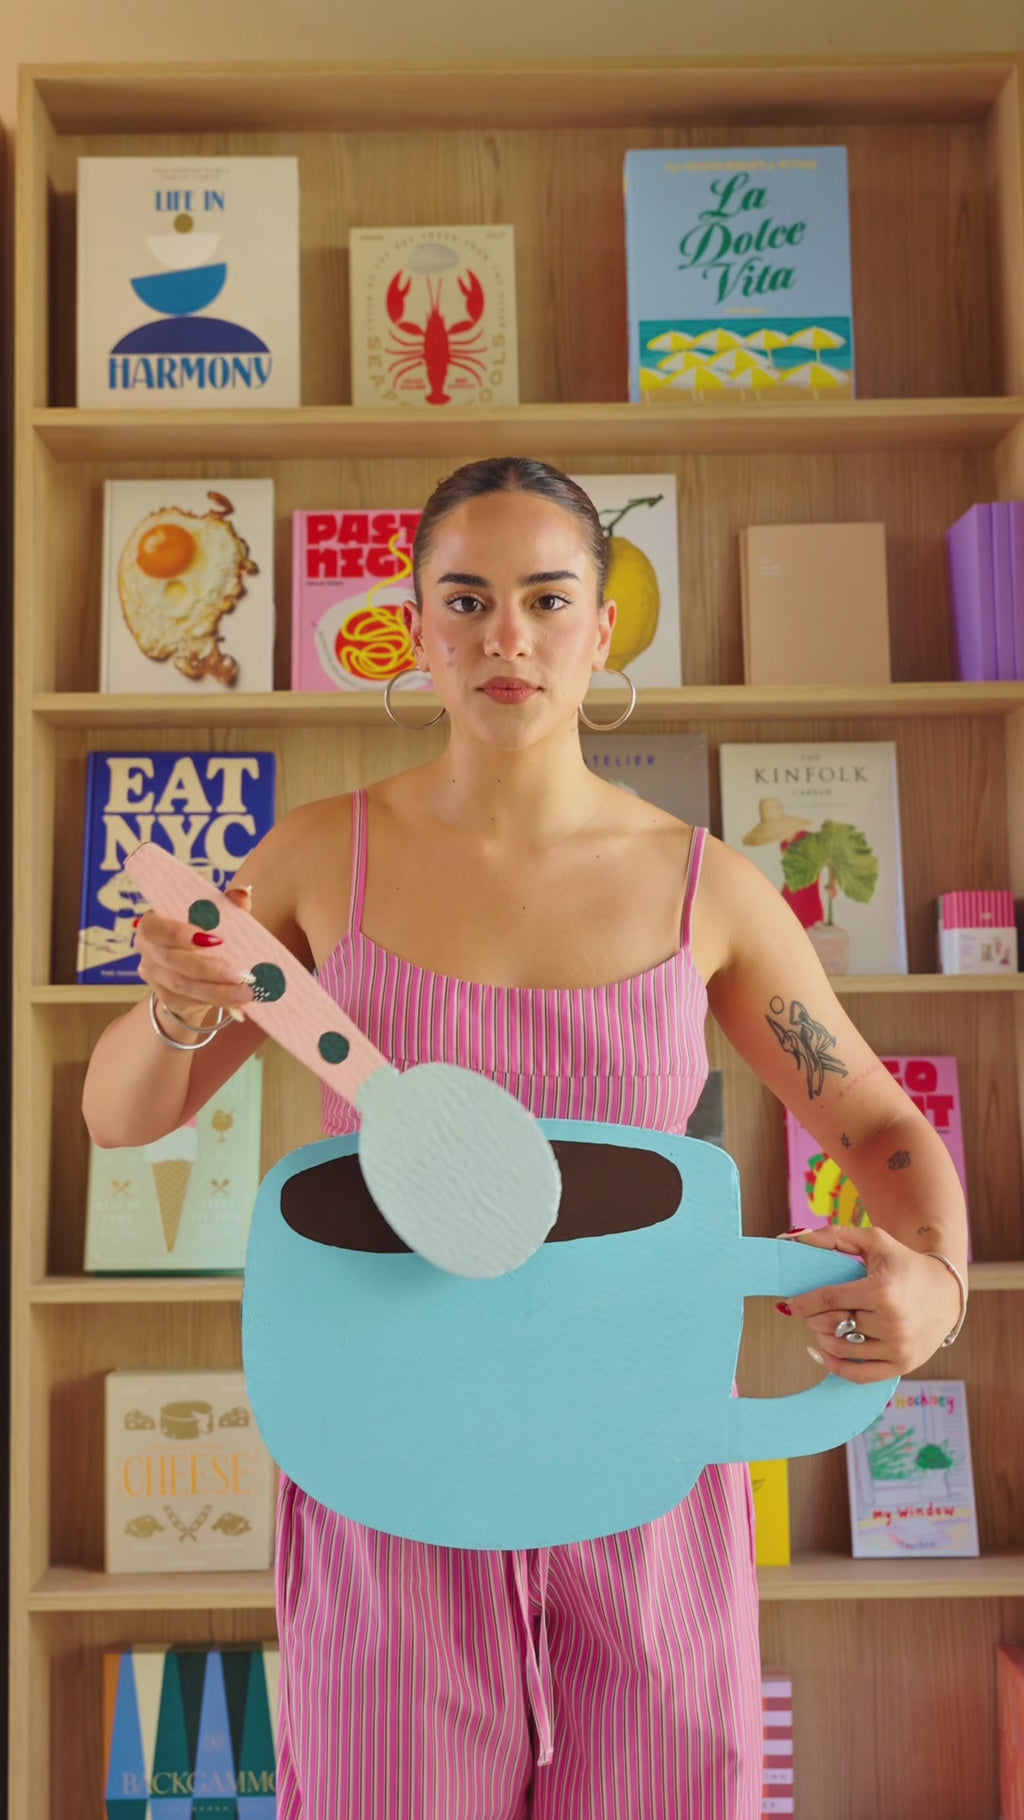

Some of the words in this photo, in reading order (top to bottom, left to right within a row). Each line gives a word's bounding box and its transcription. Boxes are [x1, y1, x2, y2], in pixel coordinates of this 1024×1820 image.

[156, 190, 193, 212] LIFE
[204, 190, 224, 212] IN
[699, 172, 767, 221] La
[678, 217, 806, 270] Dolce
[702, 256, 797, 305] Vita
[104, 756, 260, 813] EAT
[583, 755, 656, 767] TELIER
[755, 766, 868, 784] KINFOLK
[100, 814, 256, 872] NYC
[123, 1453, 254, 1497] CHEESE
